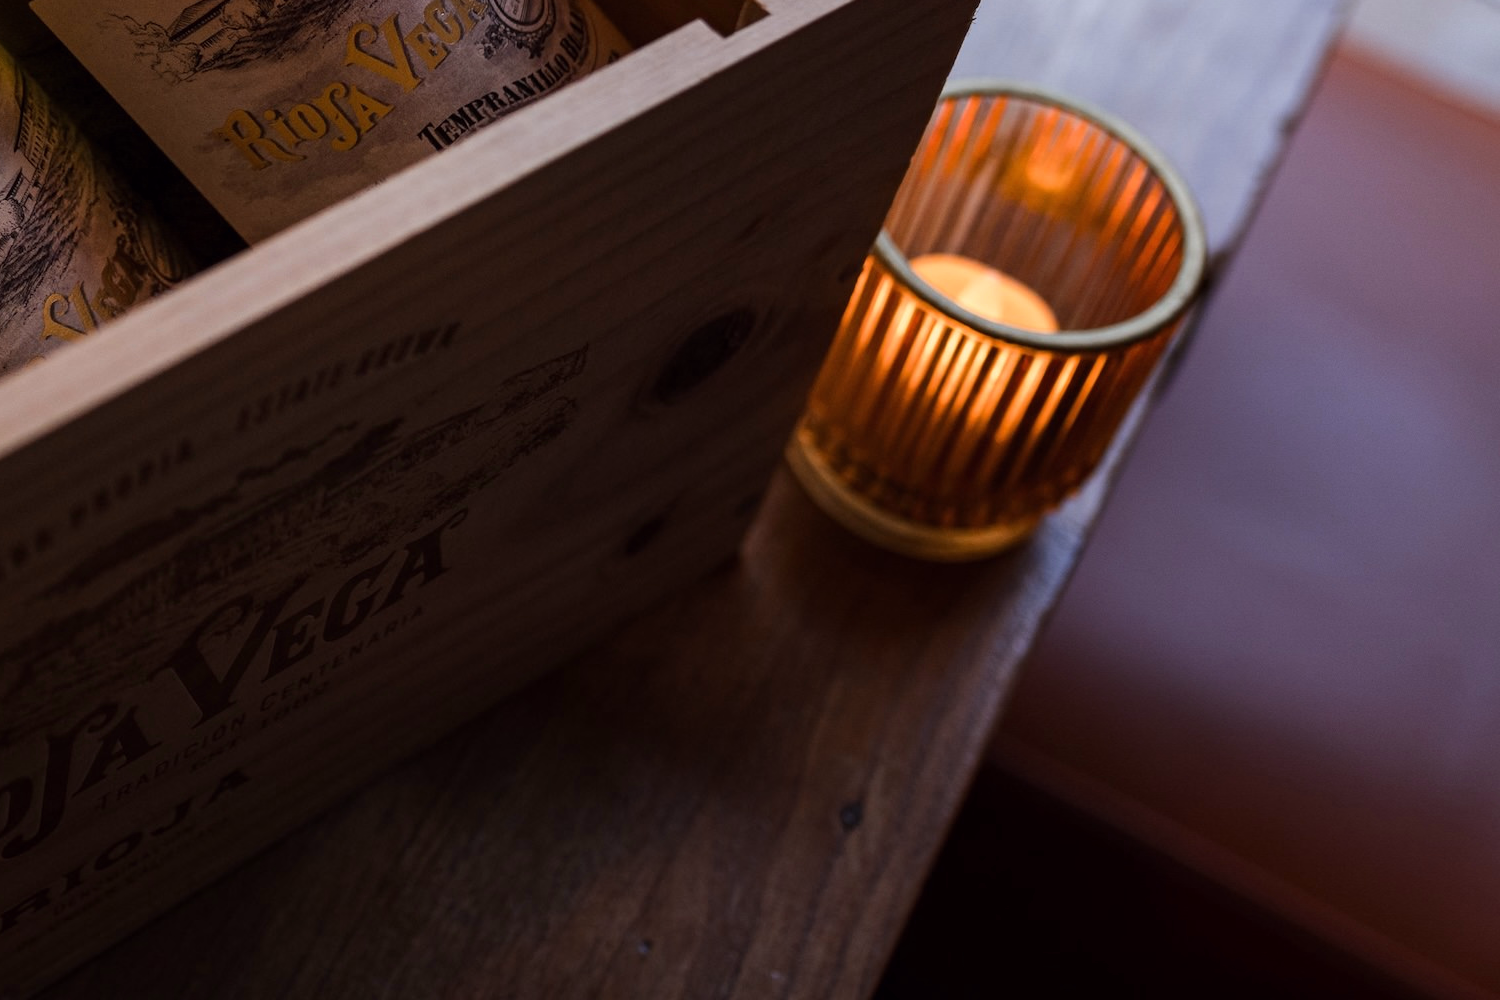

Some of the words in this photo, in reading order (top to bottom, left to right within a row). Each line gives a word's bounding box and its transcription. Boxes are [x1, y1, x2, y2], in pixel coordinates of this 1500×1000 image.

[417, 52, 571, 150] TEMPRANILLO
[147, 507, 469, 730] VEGA
[258, 606, 423, 713] CENTENARIA
